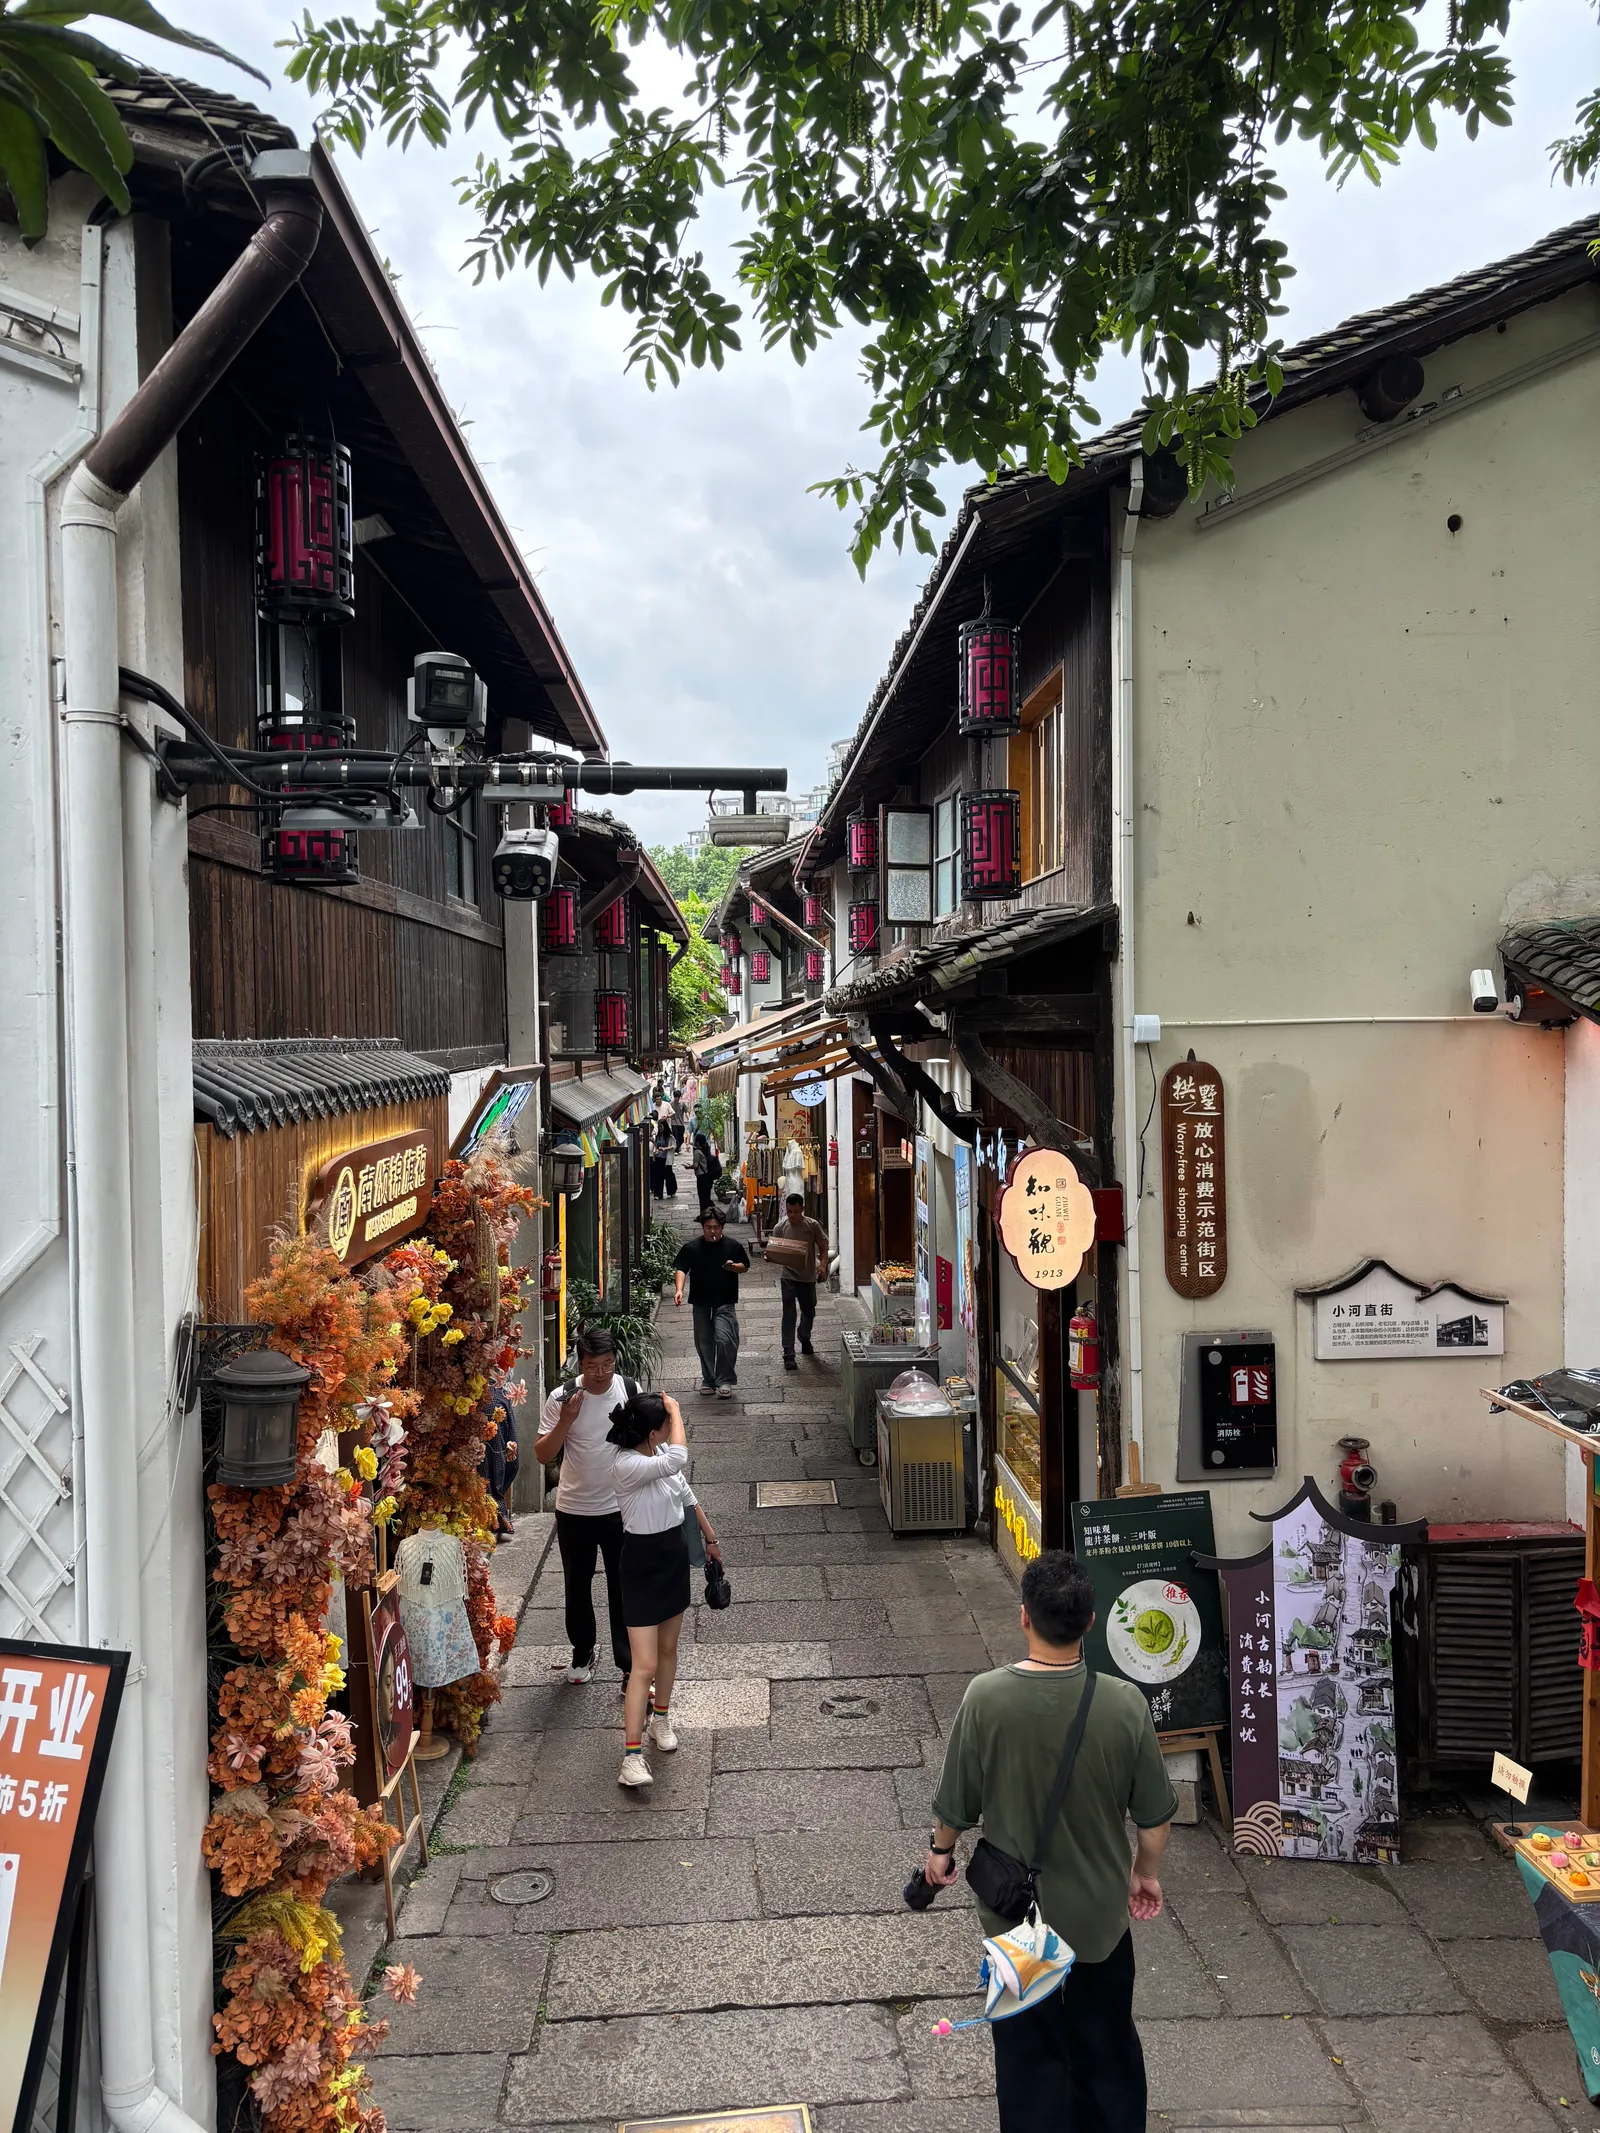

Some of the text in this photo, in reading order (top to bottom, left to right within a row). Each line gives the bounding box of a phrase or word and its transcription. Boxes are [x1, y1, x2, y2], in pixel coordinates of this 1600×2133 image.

[1176, 1122, 1190, 1277] Worry-free shopping center
[1194, 1121, 1217, 1277] 放心消费示范街区
[1034, 1269, 1063, 1279] 1913
[1332, 1303, 1393, 1317] 小河直街
[1217, 1429, 1241, 1437] 消防栓
[1083, 1524, 1111, 1536] 知味观
[1165, 1586, 1189, 1601] 推荐
[1255, 1590, 1273, 1698] 小河古韵长
[395, 1658, 409, 1710] 99
[1239, 1632, 1257, 1743] 消费乐无忧
[0, 1668, 95, 1760] 开业
